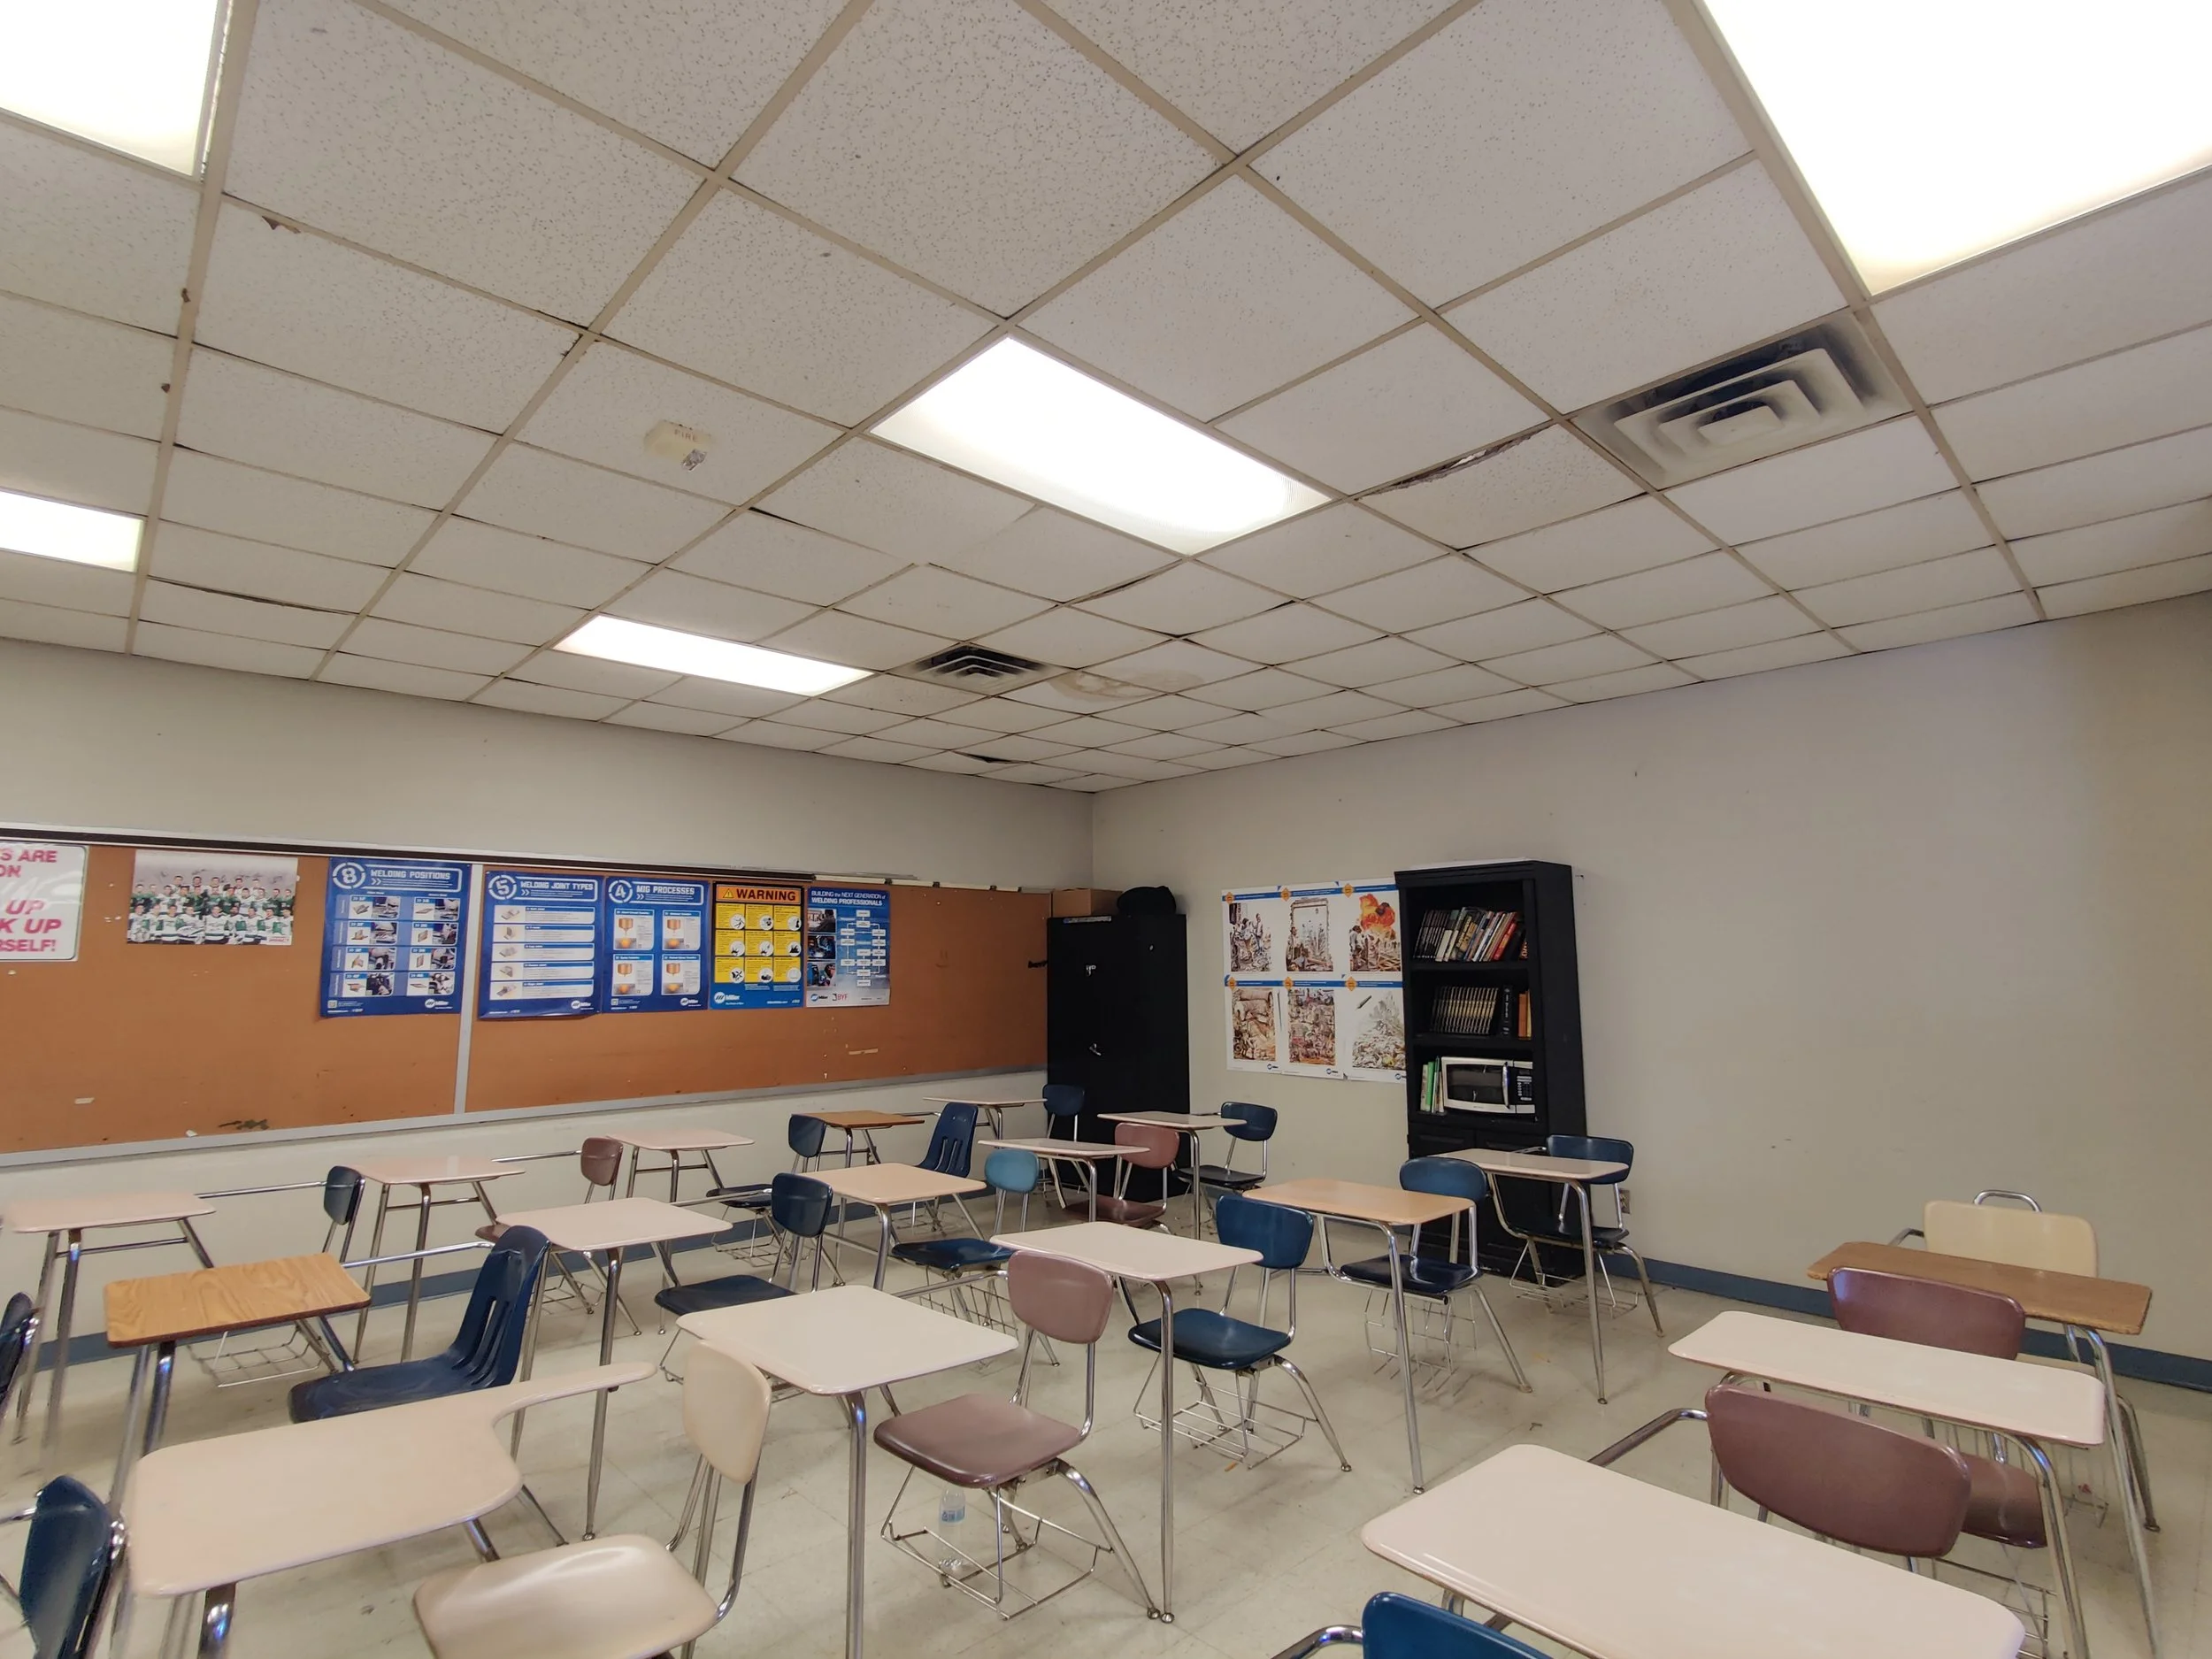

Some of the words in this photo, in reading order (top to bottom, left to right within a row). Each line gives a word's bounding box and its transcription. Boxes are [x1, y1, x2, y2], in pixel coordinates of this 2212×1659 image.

[674, 429, 697, 442] FIRE
[18, 849, 58, 863] ARE
[342, 867, 357, 884] 8
[371, 869, 406, 879] WELDING
[410, 872, 451, 880] POSITIONS
[495, 879, 510, 895] 5
[520, 880, 549, 889] WELDING
[551, 881, 571, 890] JOINT
[572, 882, 594, 891] TYPES
[615, 884, 626, 898] 4
[637, 885, 650, 894] MIG
[653, 886, 695, 895] PROCESSES
[736, 888, 796, 901] WARNING
[839, 897, 883, 906] PROFESSIONALS
[5, 900, 44, 915] UP
[24, 918, 62, 933] UP
